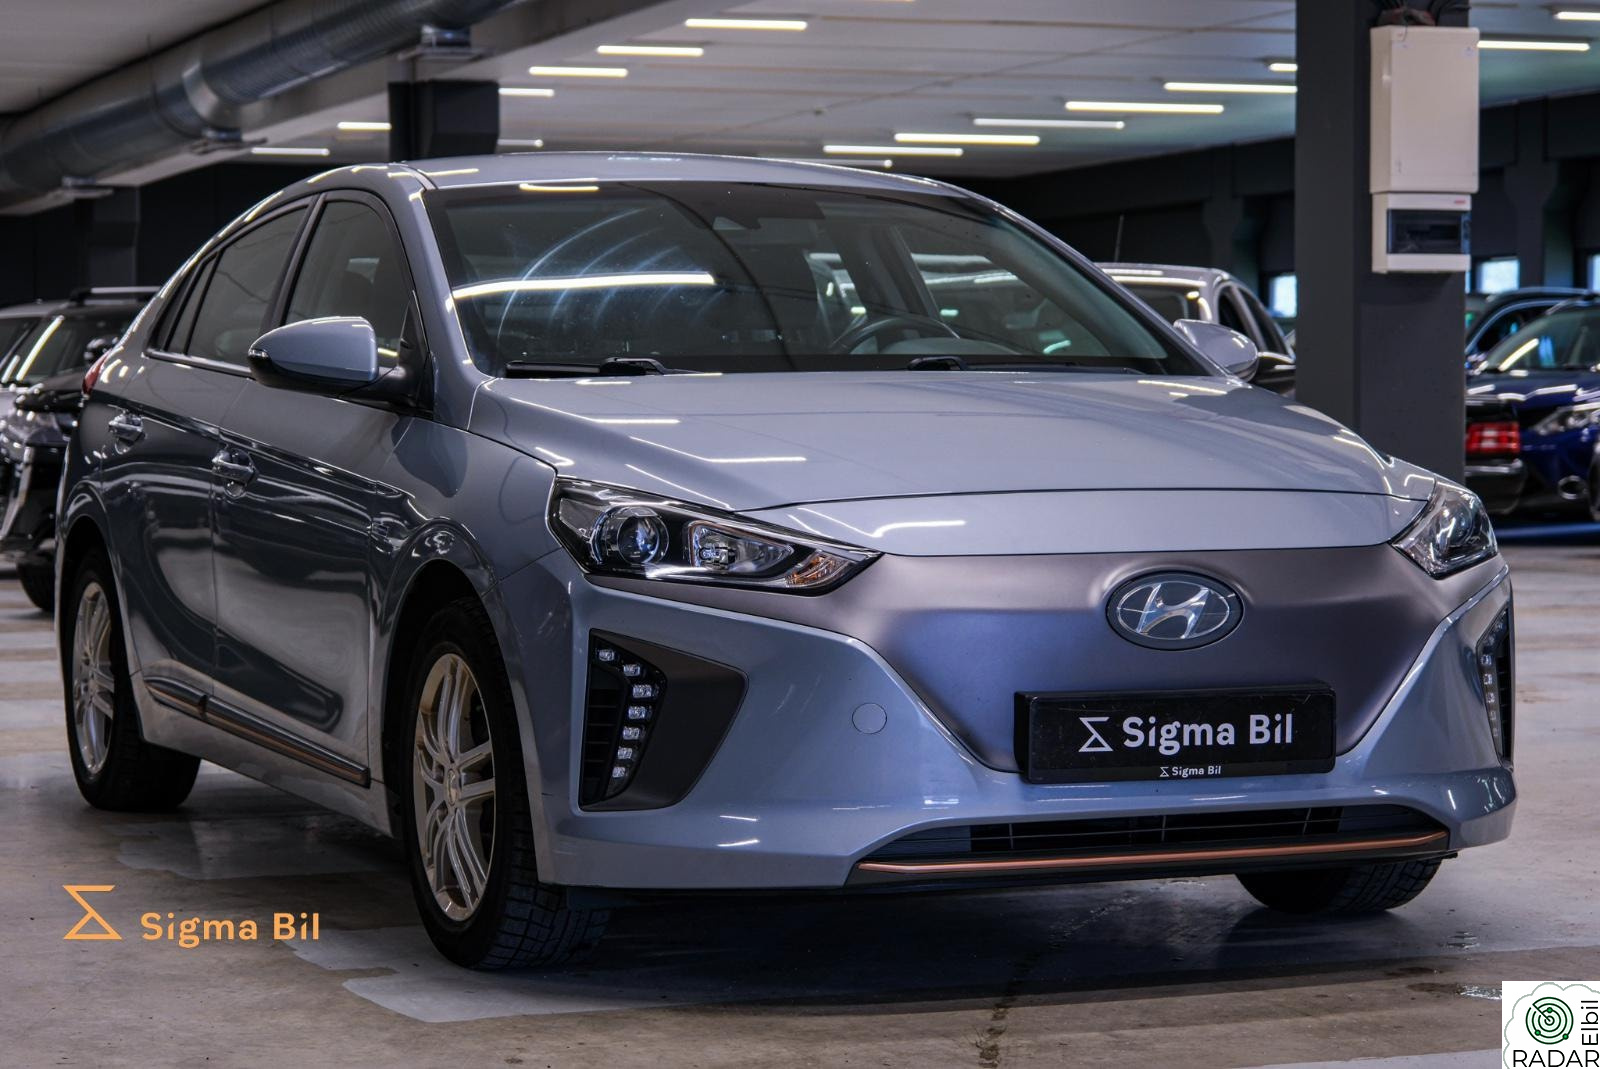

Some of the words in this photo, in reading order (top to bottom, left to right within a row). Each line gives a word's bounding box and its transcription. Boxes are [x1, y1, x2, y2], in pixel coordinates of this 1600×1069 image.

[1122, 715, 1235, 755] Sigma
[1250, 713, 1293, 743] Bil
[1172, 766, 1204, 778] Sigma
[1207, 765, 1221, 775] Bil
